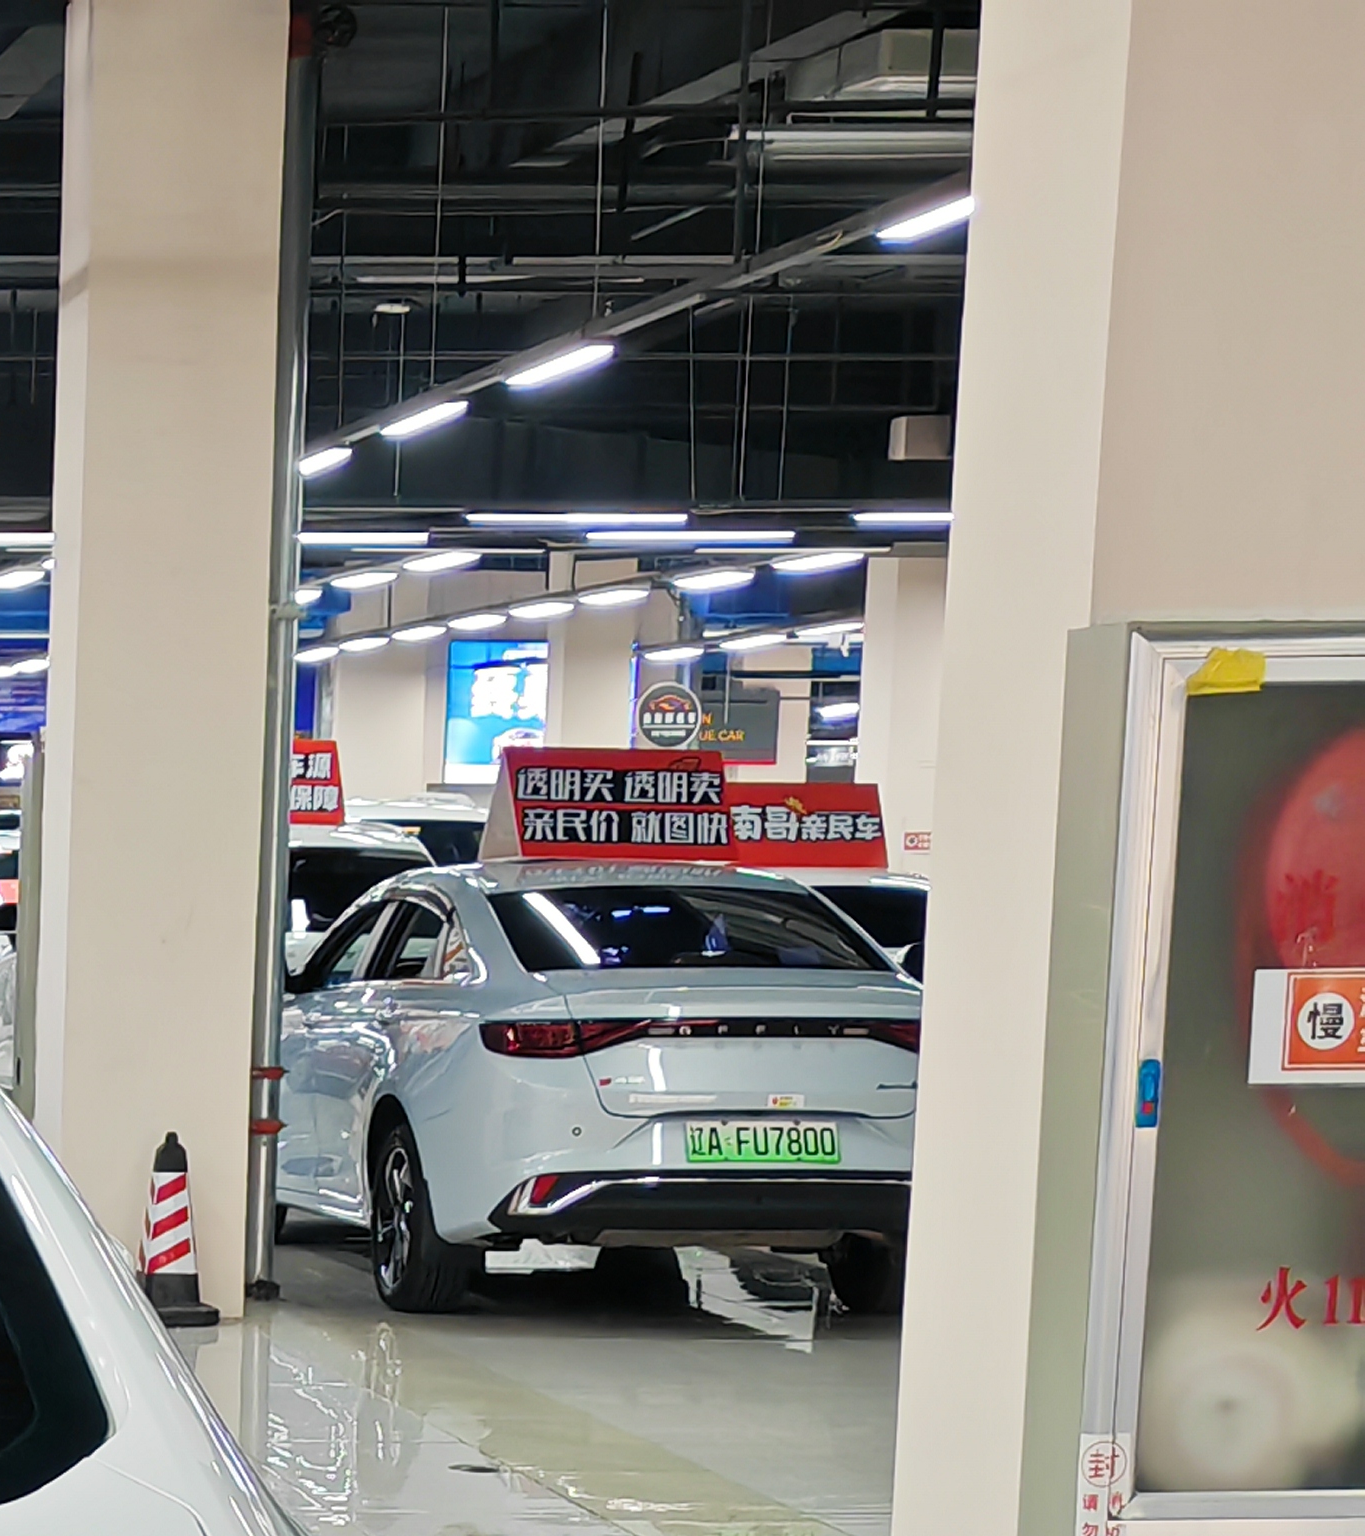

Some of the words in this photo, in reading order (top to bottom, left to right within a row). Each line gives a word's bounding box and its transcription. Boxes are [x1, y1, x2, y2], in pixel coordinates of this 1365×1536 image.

[516, 768, 616, 802] 透明买
[624, 769, 723, 805] 透明卖
[523, 807, 620, 843] 亲民价
[630, 811, 729, 845] 就图快
[730, 805, 883, 842] 南哥亲民车
[1307, 1002, 1345, 1041] 慢
